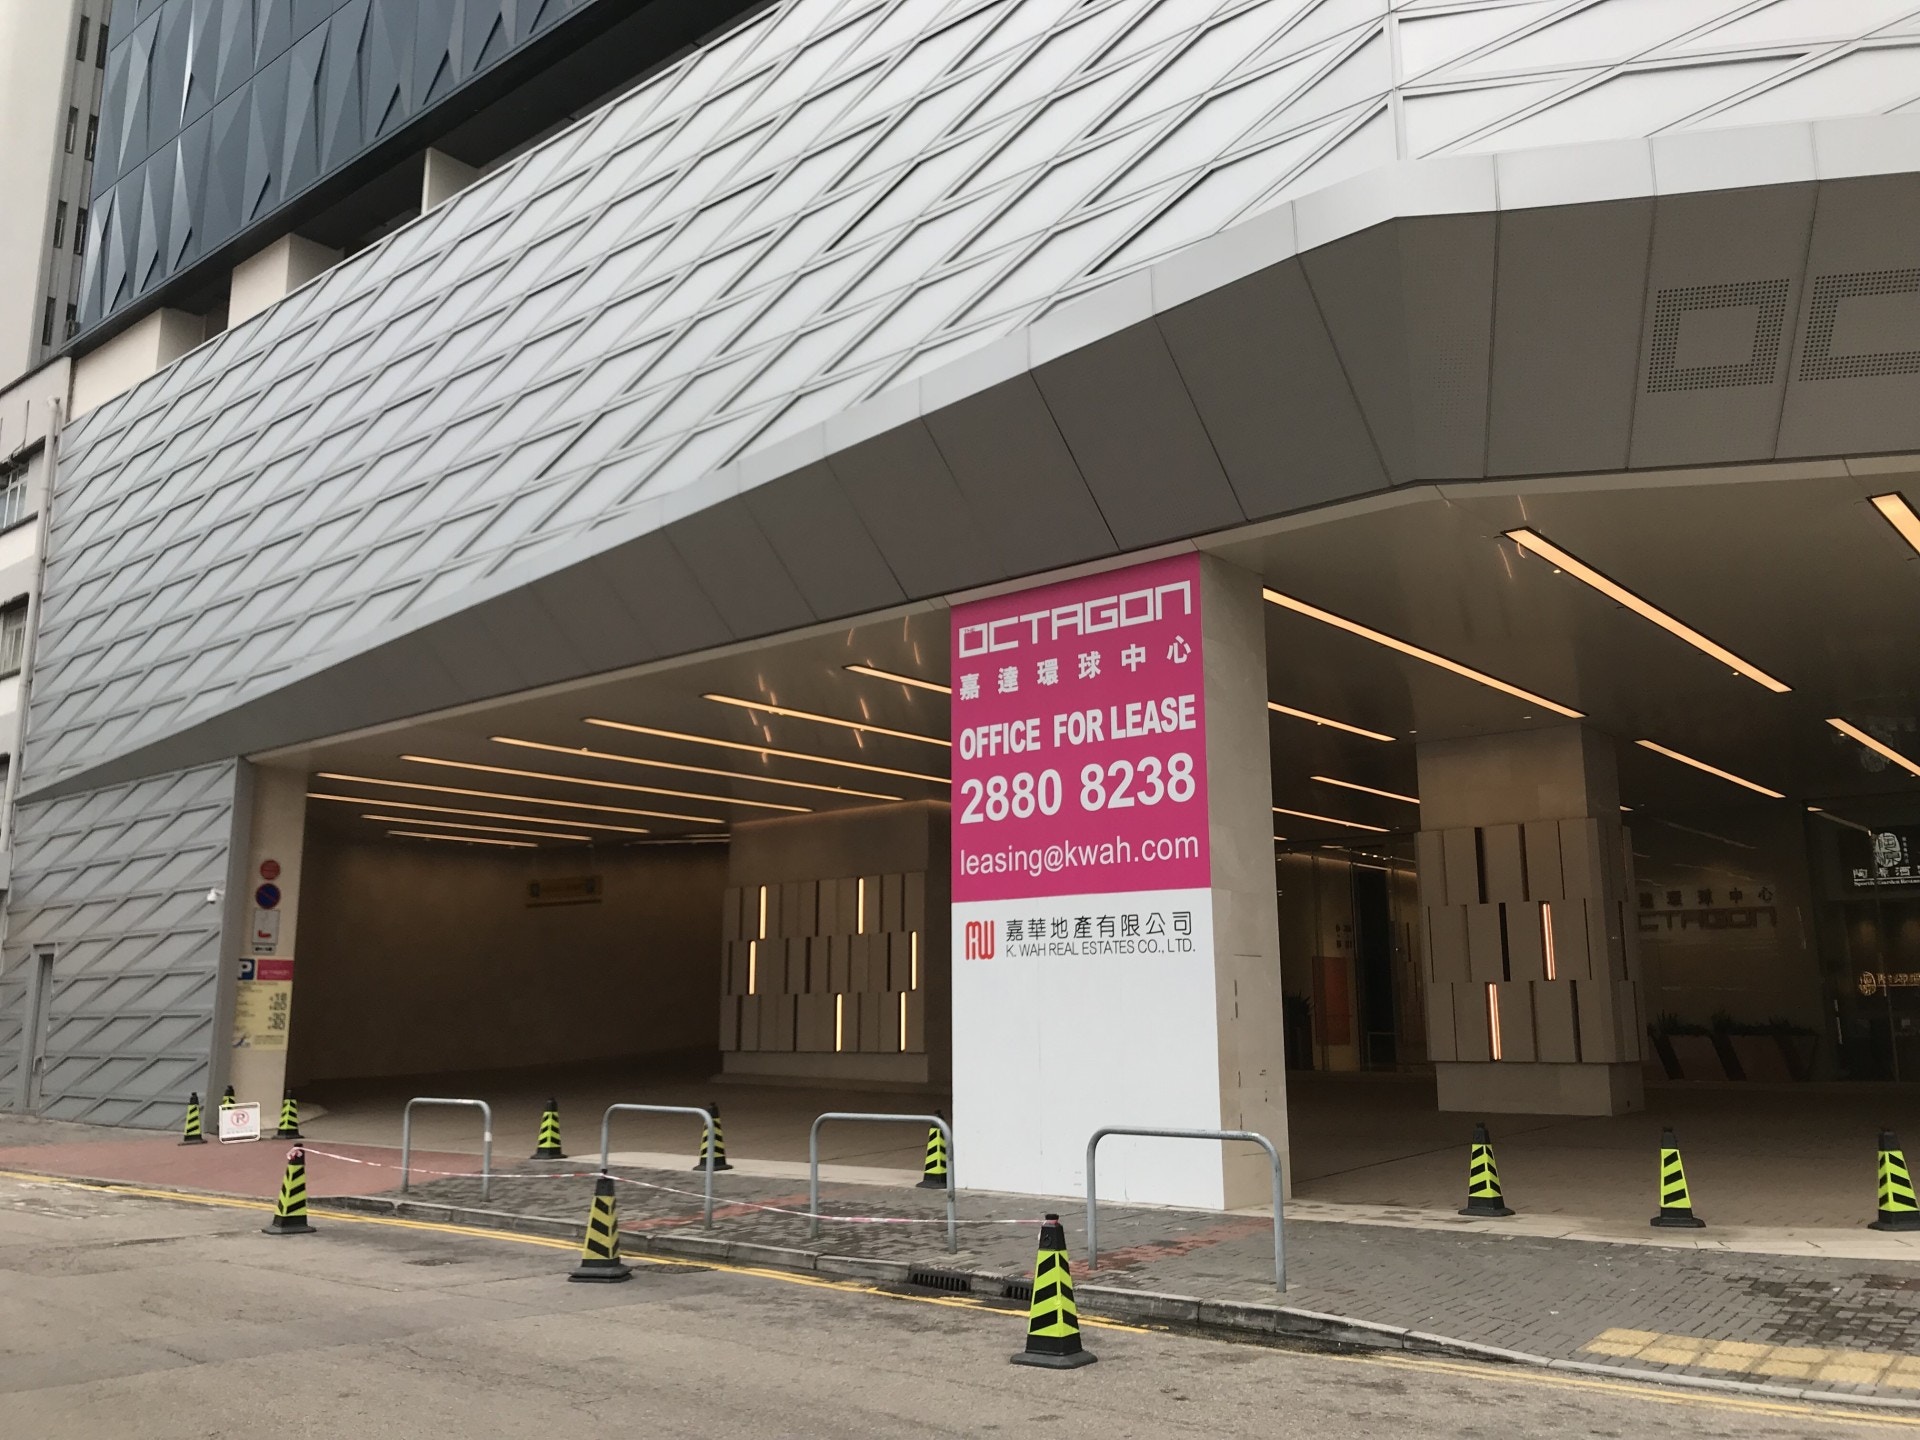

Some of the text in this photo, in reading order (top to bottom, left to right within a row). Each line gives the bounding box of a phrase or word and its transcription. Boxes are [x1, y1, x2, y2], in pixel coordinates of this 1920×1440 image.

[958, 580, 1192, 659] OCTAGON
[959, 635, 1192, 701] 嘉達環球中心
[959, 693, 1197, 760] OFFICE FOR LEASE
[959, 752, 1196, 825] 2880 8238
[960, 835, 1199, 877] leasing@kwah.com
[1005, 911, 1193, 942] 嘉華地產有限公司
[1005, 937, 1196, 958] K. WAH REAL ESTATES CO., LTD.
